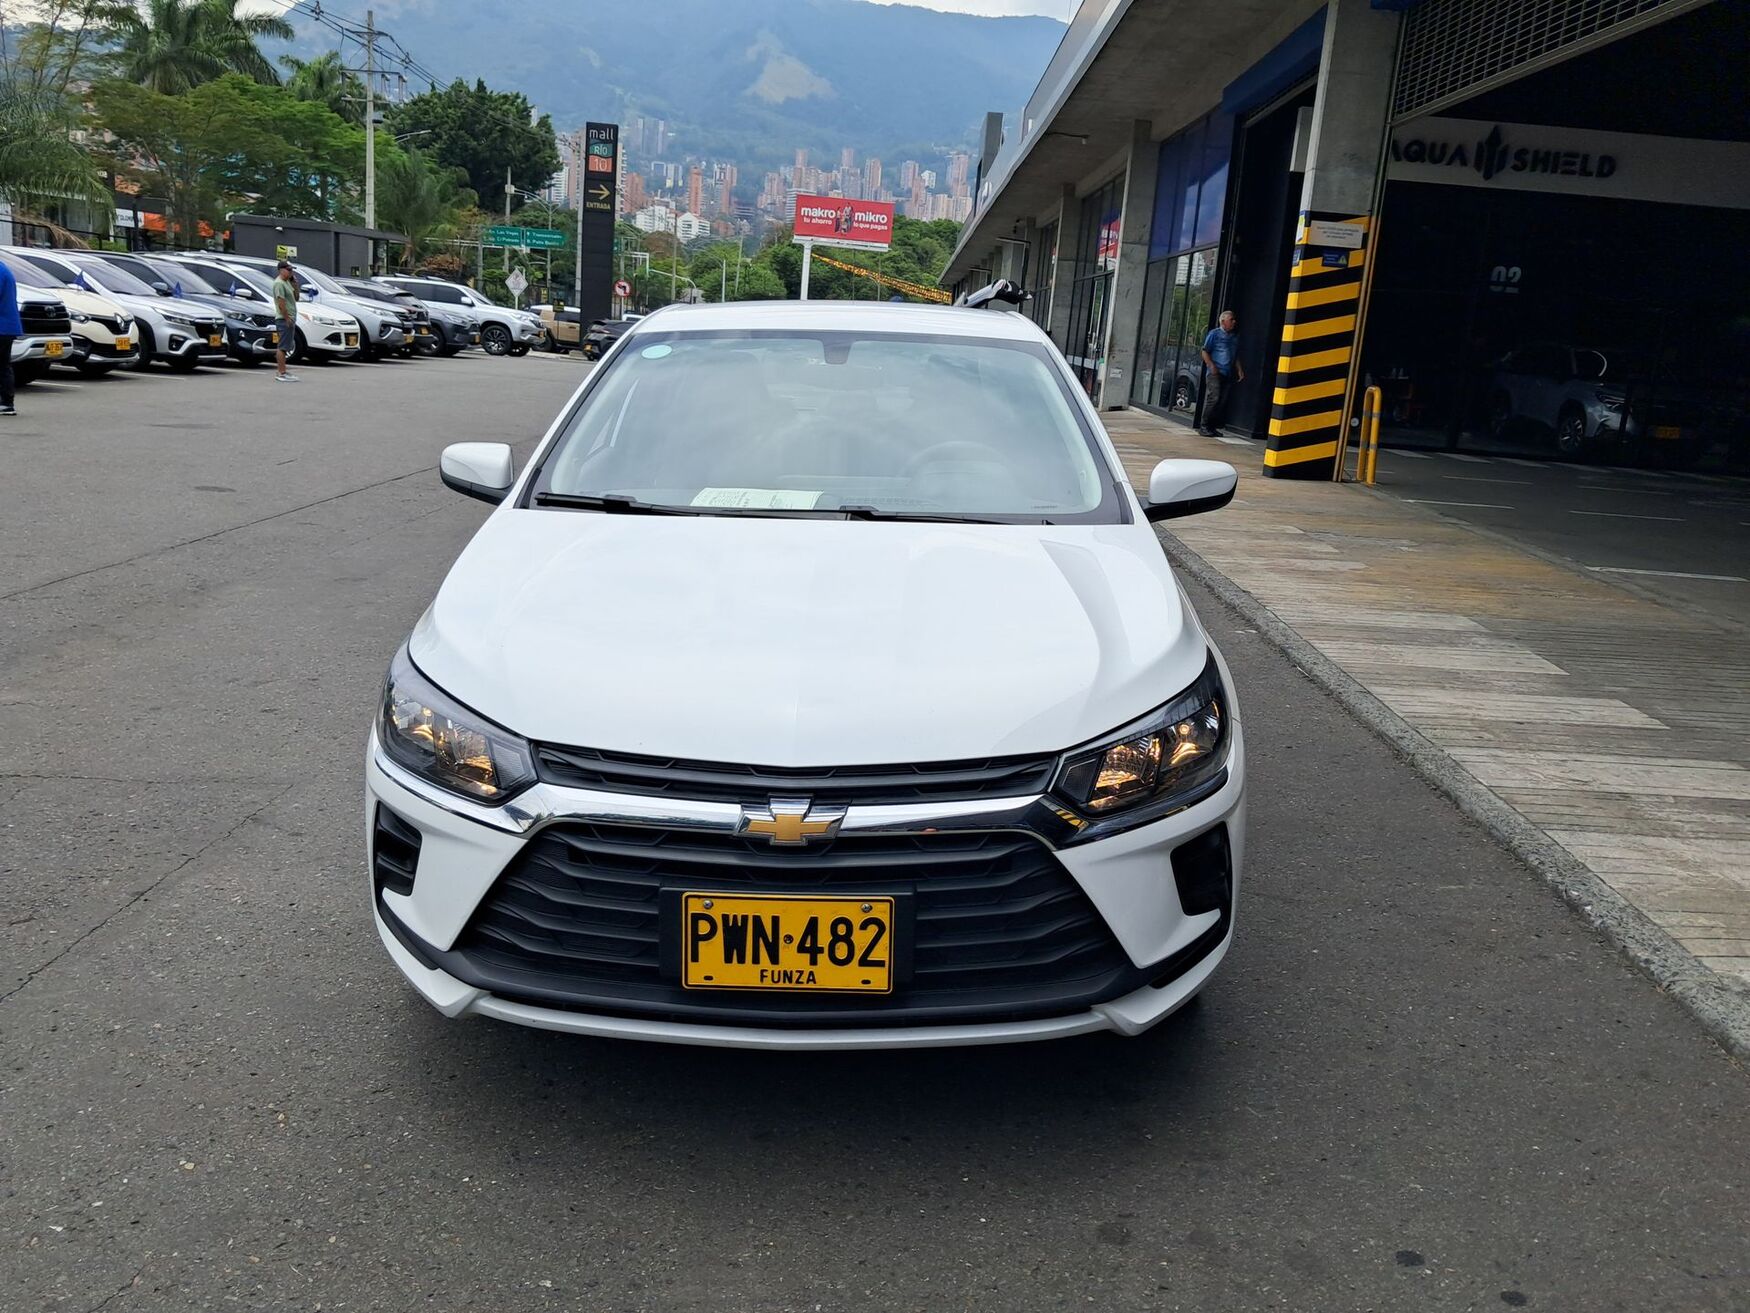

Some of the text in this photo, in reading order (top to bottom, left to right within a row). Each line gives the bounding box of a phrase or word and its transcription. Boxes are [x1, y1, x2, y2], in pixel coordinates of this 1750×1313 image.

[589, 128, 614, 140] mall
[1511, 148, 1618, 179] SHIELD
[586, 201, 611, 210] ENTRADA
[801, 207, 888, 224] makro mikro
[811, 217, 833, 225] ahorro
[870, 223, 888, 231] pagas
[1489, 265, 1522, 294] 02
[759, 968, 817, 985] FUNZA
